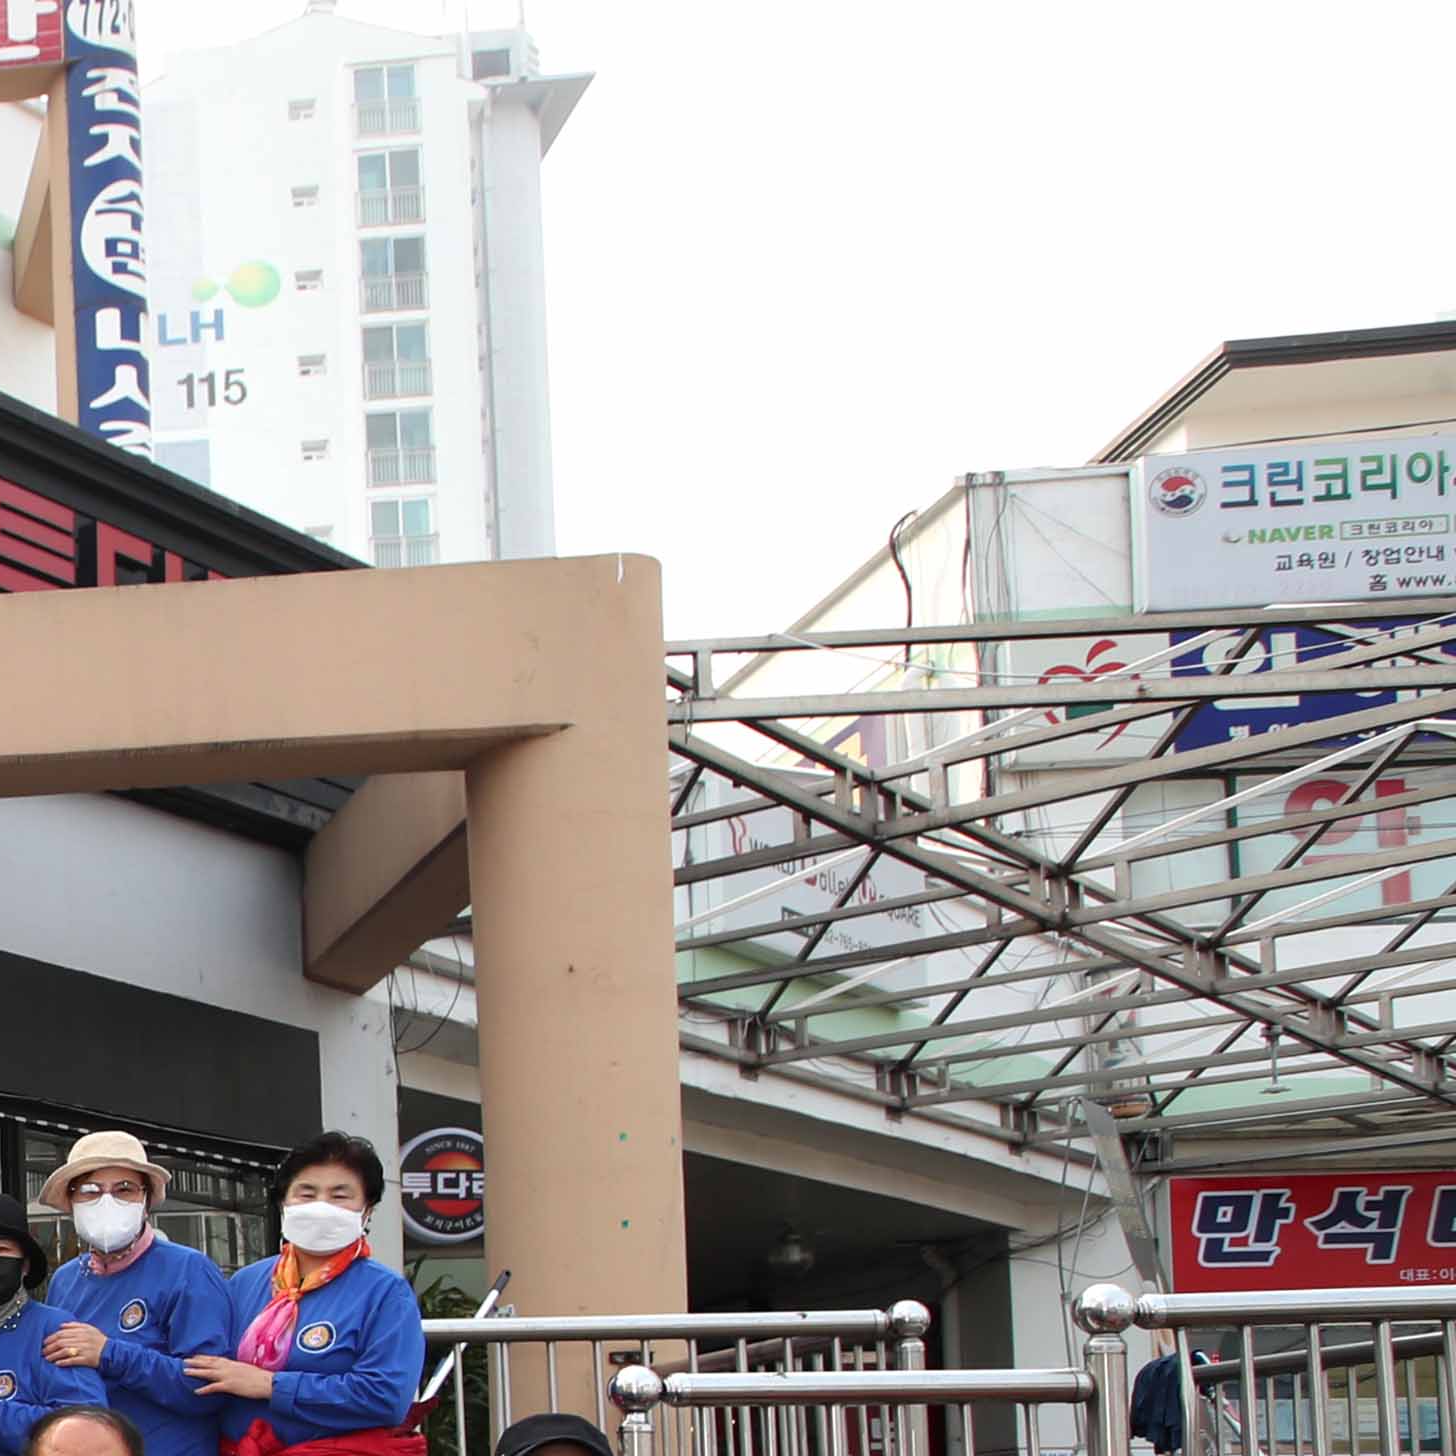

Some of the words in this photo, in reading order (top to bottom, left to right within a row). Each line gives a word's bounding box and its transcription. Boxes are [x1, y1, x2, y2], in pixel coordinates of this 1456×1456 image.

[157, 308, 225, 347] LH
[176, 368, 248, 409] 115
[1219, 450, 1456, 509] 크린코리아
[1247, 523, 1335, 546] NAVER
[1274, 551, 1337, 573] 교육원
[1361, 544, 1445, 568] 창업안내
[1396, 573, 1456, 591] www.
